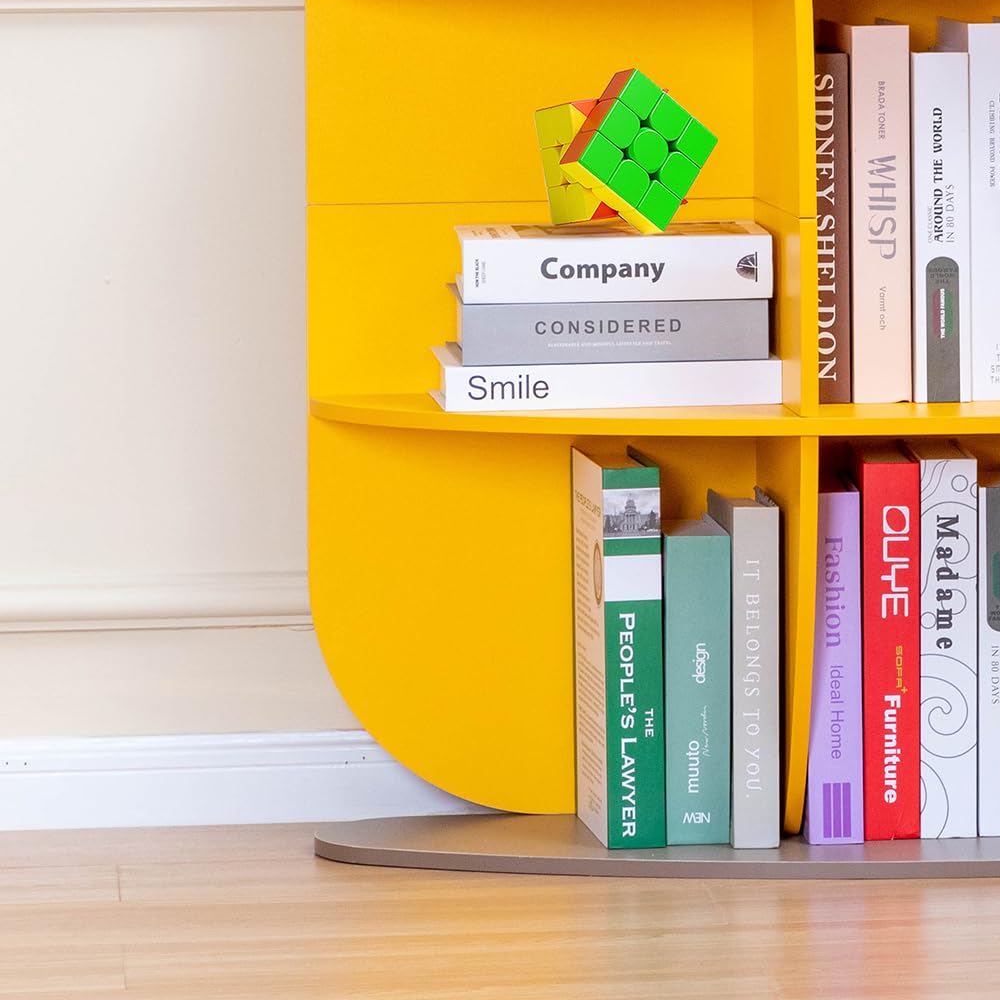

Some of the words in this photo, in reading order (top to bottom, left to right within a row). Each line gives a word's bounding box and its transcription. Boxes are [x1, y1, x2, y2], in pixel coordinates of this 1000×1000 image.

[814, 73, 835, 206] SIDNEY
[878, 112, 886, 140] TONER
[932, 107, 943, 155] WORLD
[933, 159, 943, 185] THE
[868, 155, 897, 260] WHISP
[933, 188, 944, 243] AROUND
[946, 184, 955, 211] DAYS
[946, 214, 955, 228] 80
[946, 231, 955, 243] IN
[540, 257, 665, 283] Company
[816, 214, 837, 382] SHELDON
[535, 319, 682, 336] CONSIDERED
[468, 375, 550, 401] Smile
[743, 560, 760, 582] IT
[936, 514, 960, 650] Madame
[825, 536, 847, 648] Fashion
[692, 643, 710, 684] design
[743, 593, 760, 698] BELONGS
[991, 646, 999, 656] IN
[619, 612, 636, 730] PEOPLE'S
[830, 665, 844, 704] Ideal
[991, 661, 999, 672] 80
[991, 676, 999, 704] DAYS
[644, 708, 654, 737] THE
[744, 709, 760, 737] TO
[830, 709, 844, 760] Home
[686, 740, 700, 793] muuto
[884, 694, 901, 804] Furniture
[621, 737, 637, 838] LAWYER
[745, 746, 761, 800] YOU.
[683, 812, 710, 824] NEW
